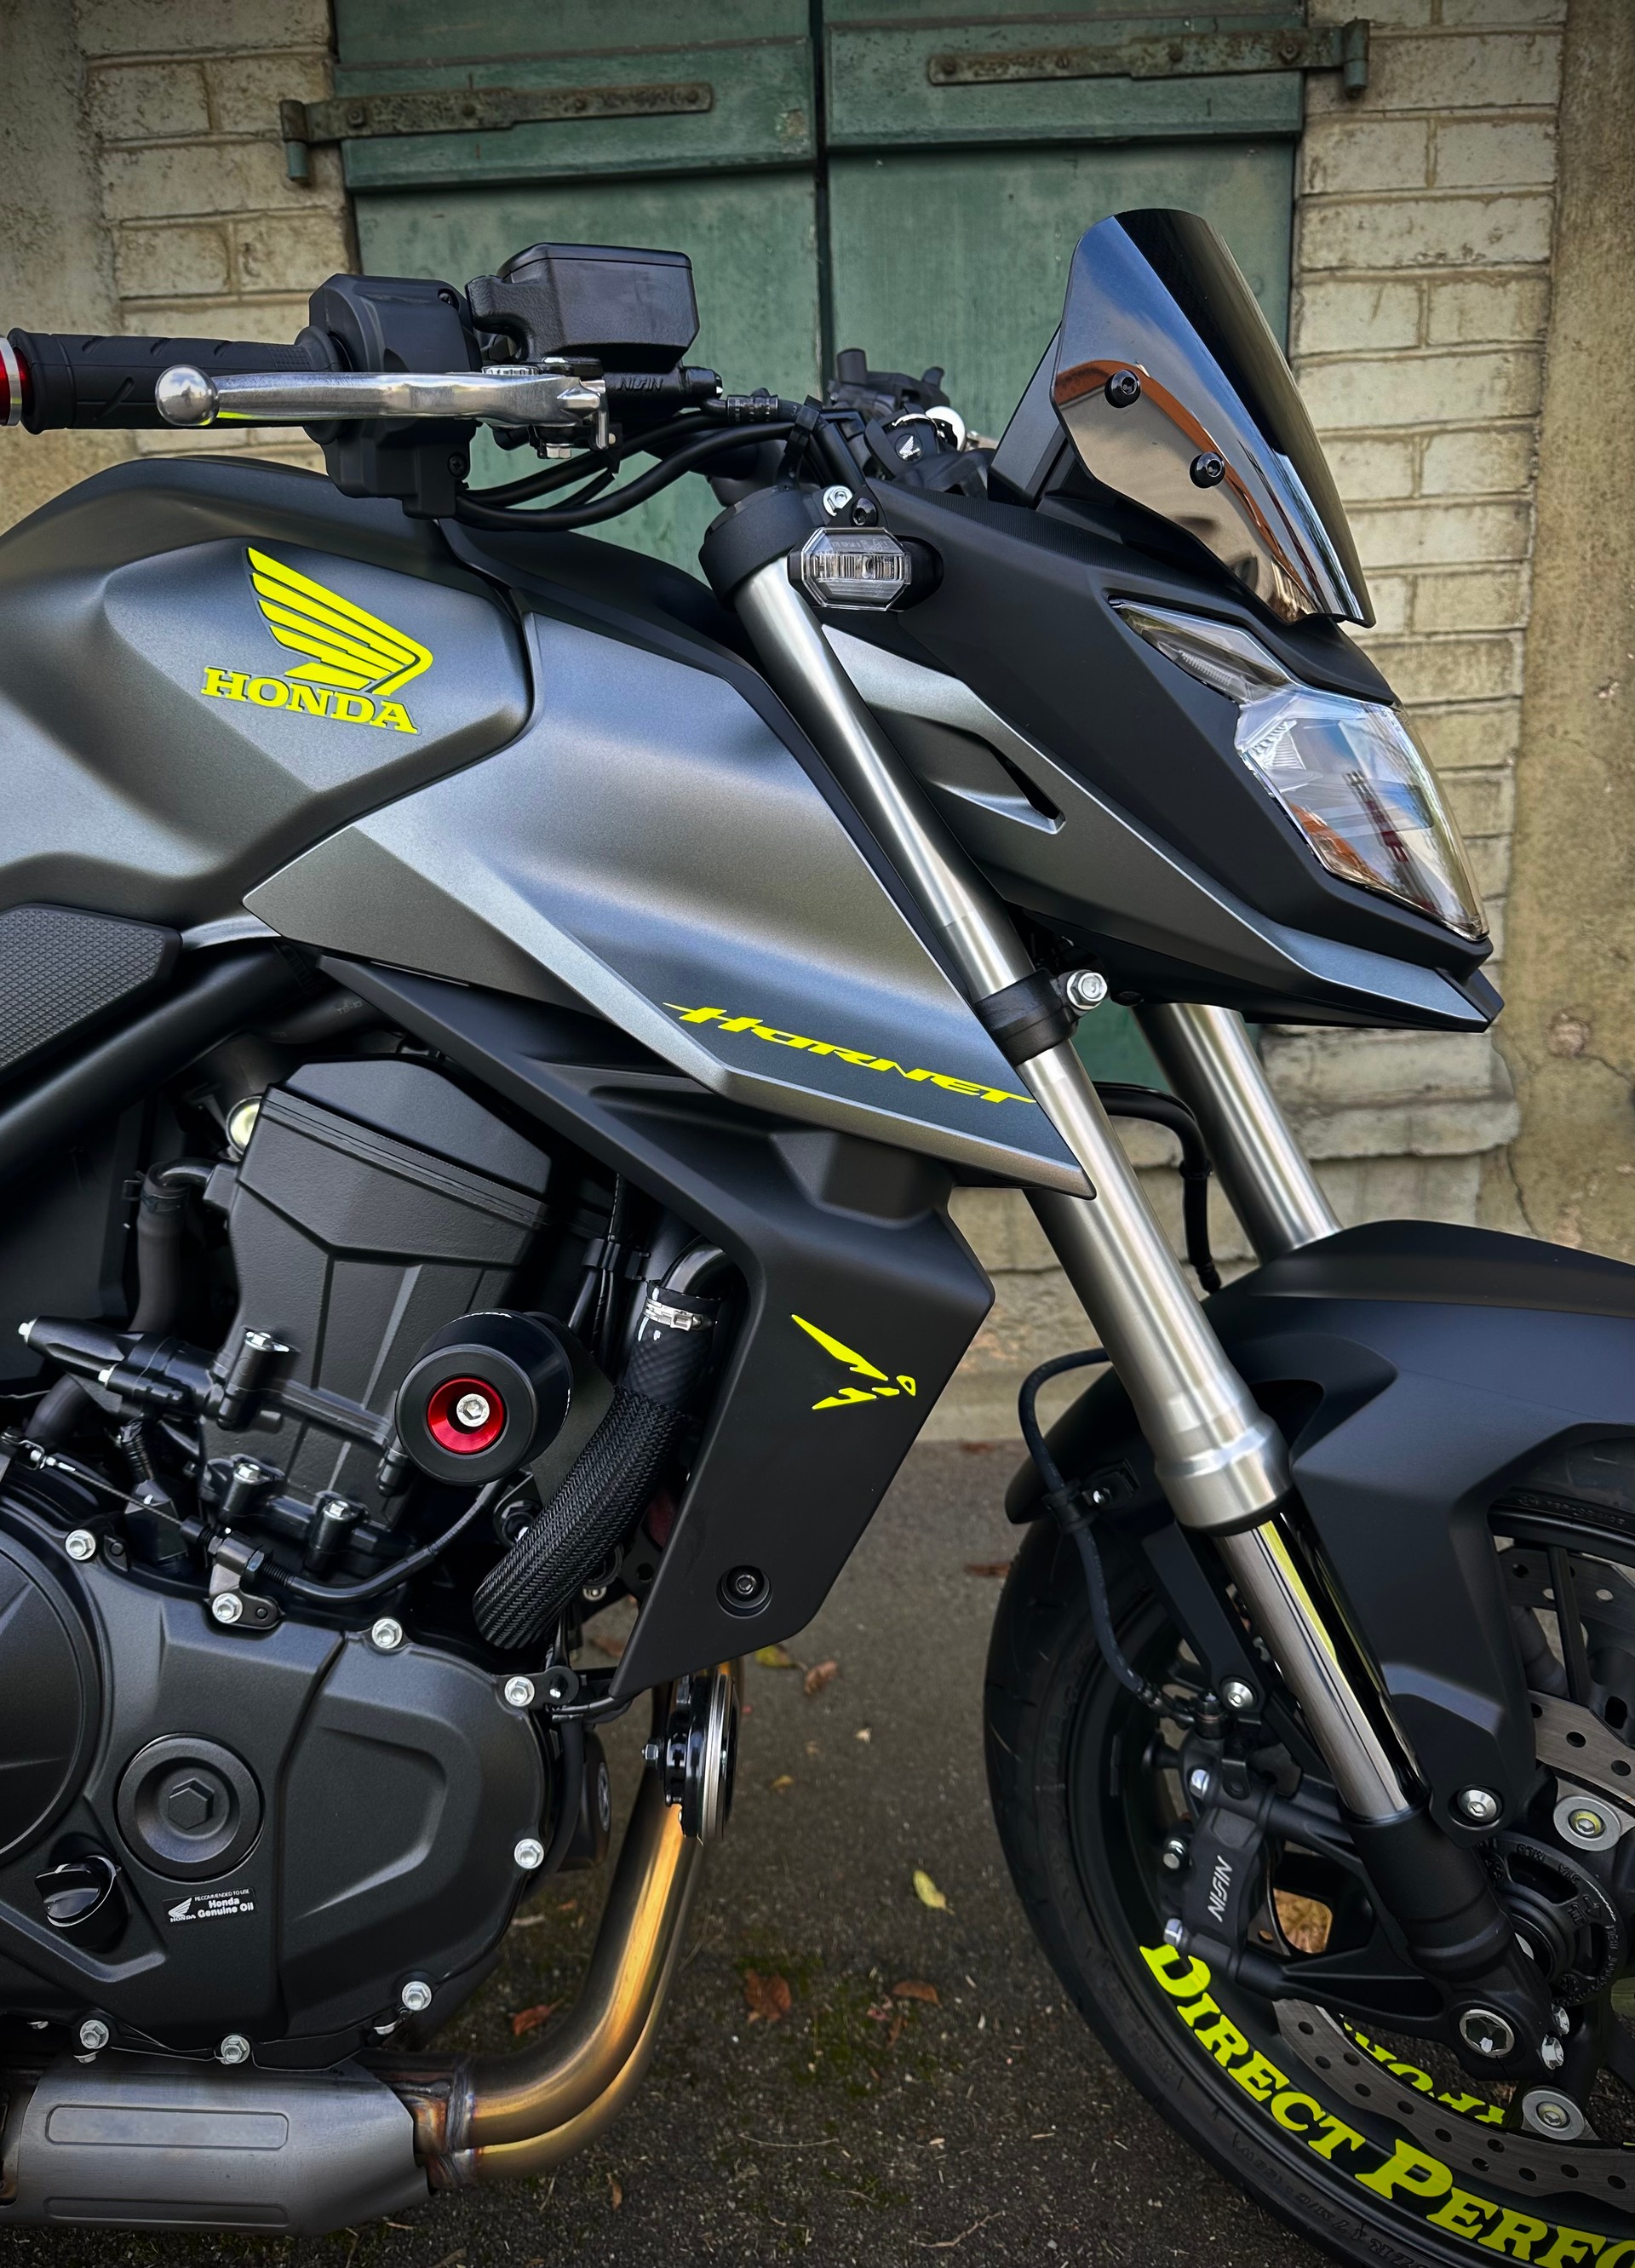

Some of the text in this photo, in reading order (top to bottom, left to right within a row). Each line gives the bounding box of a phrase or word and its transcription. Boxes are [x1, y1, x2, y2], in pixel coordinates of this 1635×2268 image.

[201, 667, 417, 734] HONDA
[194, 1891, 232, 1901] RECOMMENDED
[209, 1898, 239, 1908] Honda
[198, 1902, 254, 1918] Genuine Oil
[1139, 1944, 1365, 2160] DIRECT
